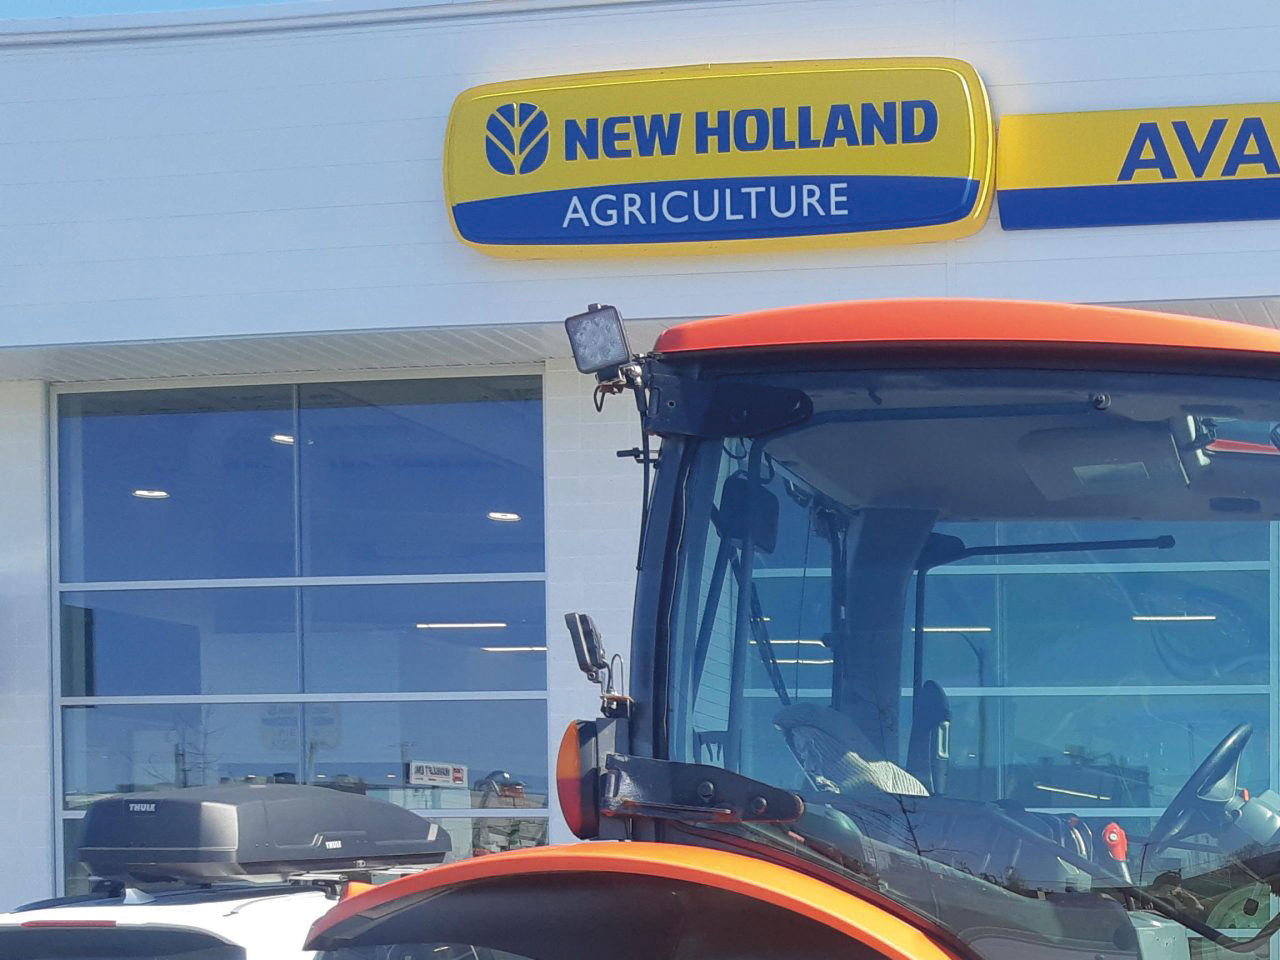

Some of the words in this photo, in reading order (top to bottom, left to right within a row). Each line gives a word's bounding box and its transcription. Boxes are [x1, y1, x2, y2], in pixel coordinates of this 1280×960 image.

[564, 112, 682, 161] NEW
[695, 99, 939, 155] HOLLAND
[562, 183, 849, 228] AGRICULTURE
[129, 803, 156, 812] THULE
